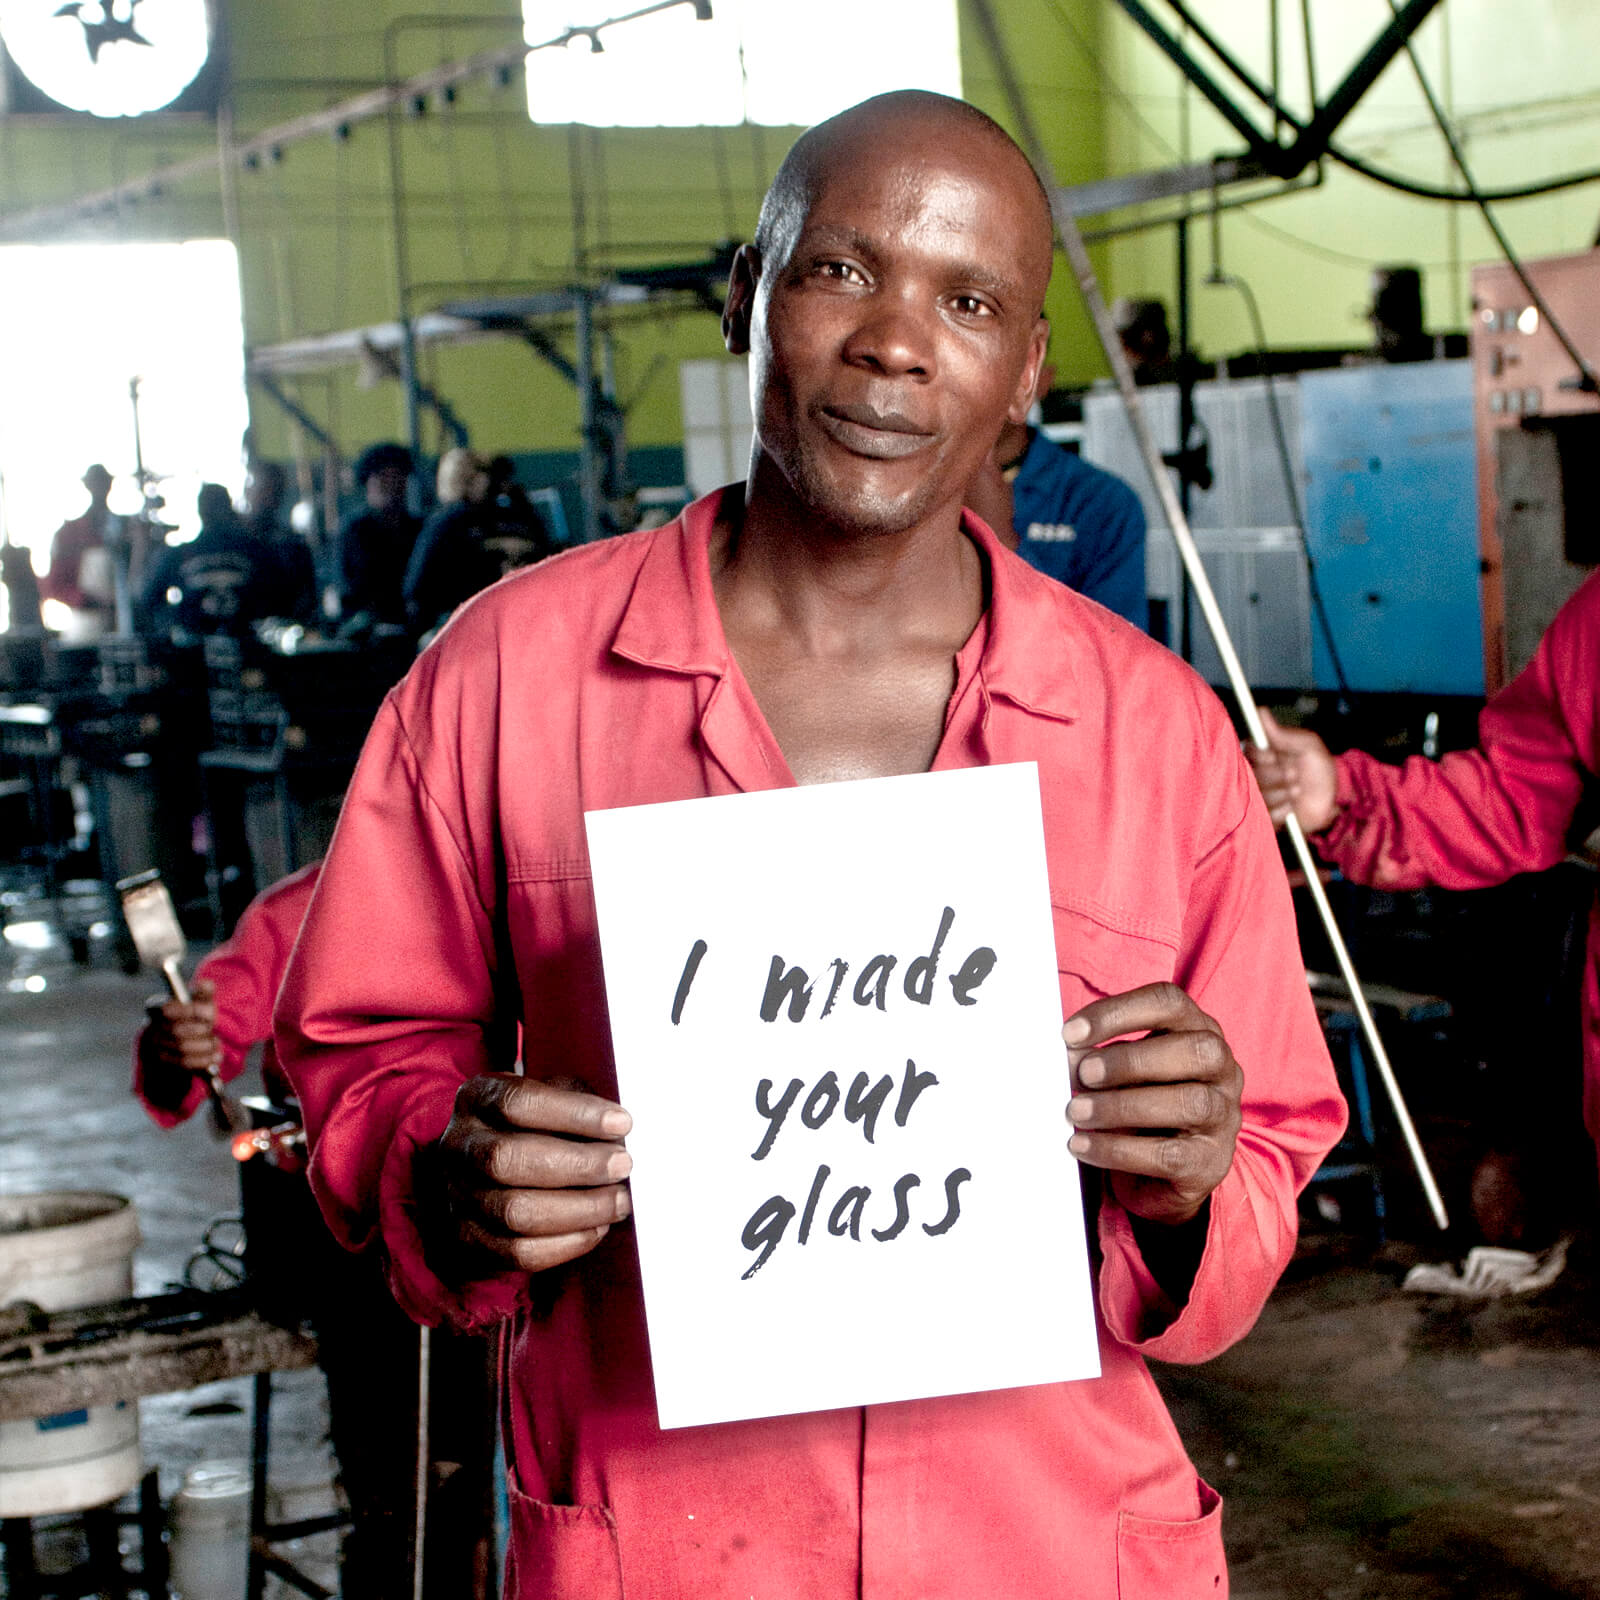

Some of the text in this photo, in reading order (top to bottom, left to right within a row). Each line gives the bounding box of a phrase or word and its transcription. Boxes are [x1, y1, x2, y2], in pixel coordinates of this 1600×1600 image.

[671, 906, 998, 1026] I made
[750, 1058, 940, 1161] your
[740, 1164, 972, 1281] glass
